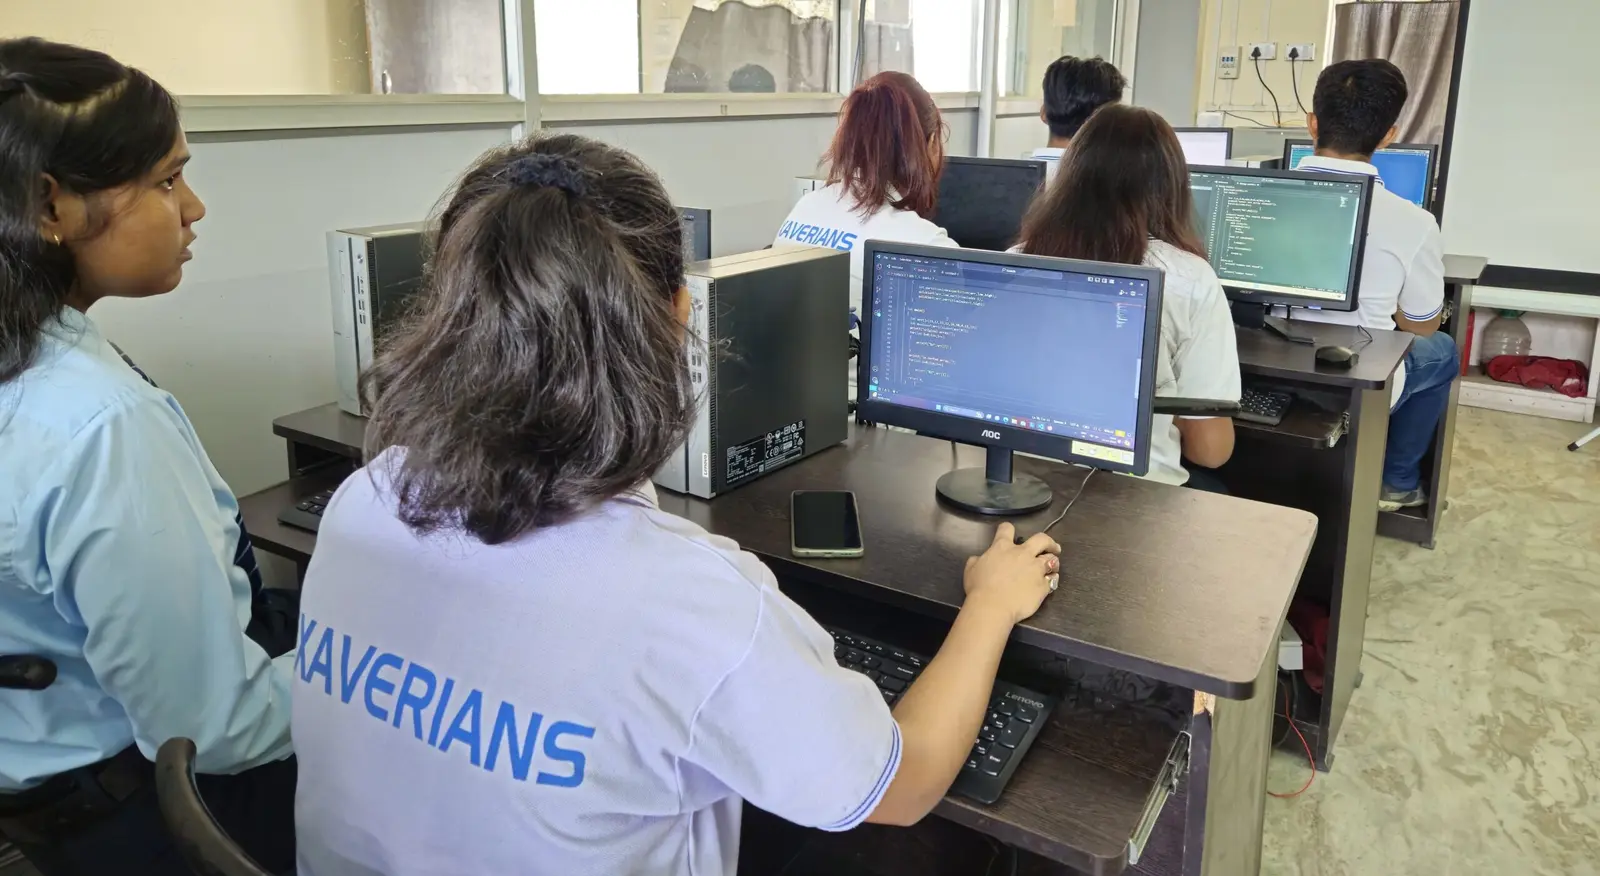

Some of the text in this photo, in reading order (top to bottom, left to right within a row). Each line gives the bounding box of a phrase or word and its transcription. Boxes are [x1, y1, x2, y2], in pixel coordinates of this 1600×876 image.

[981, 429, 1001, 440] AOC
[293, 613, 596, 788] XAVERIANS
[1005, 691, 1044, 709] Lenovo
